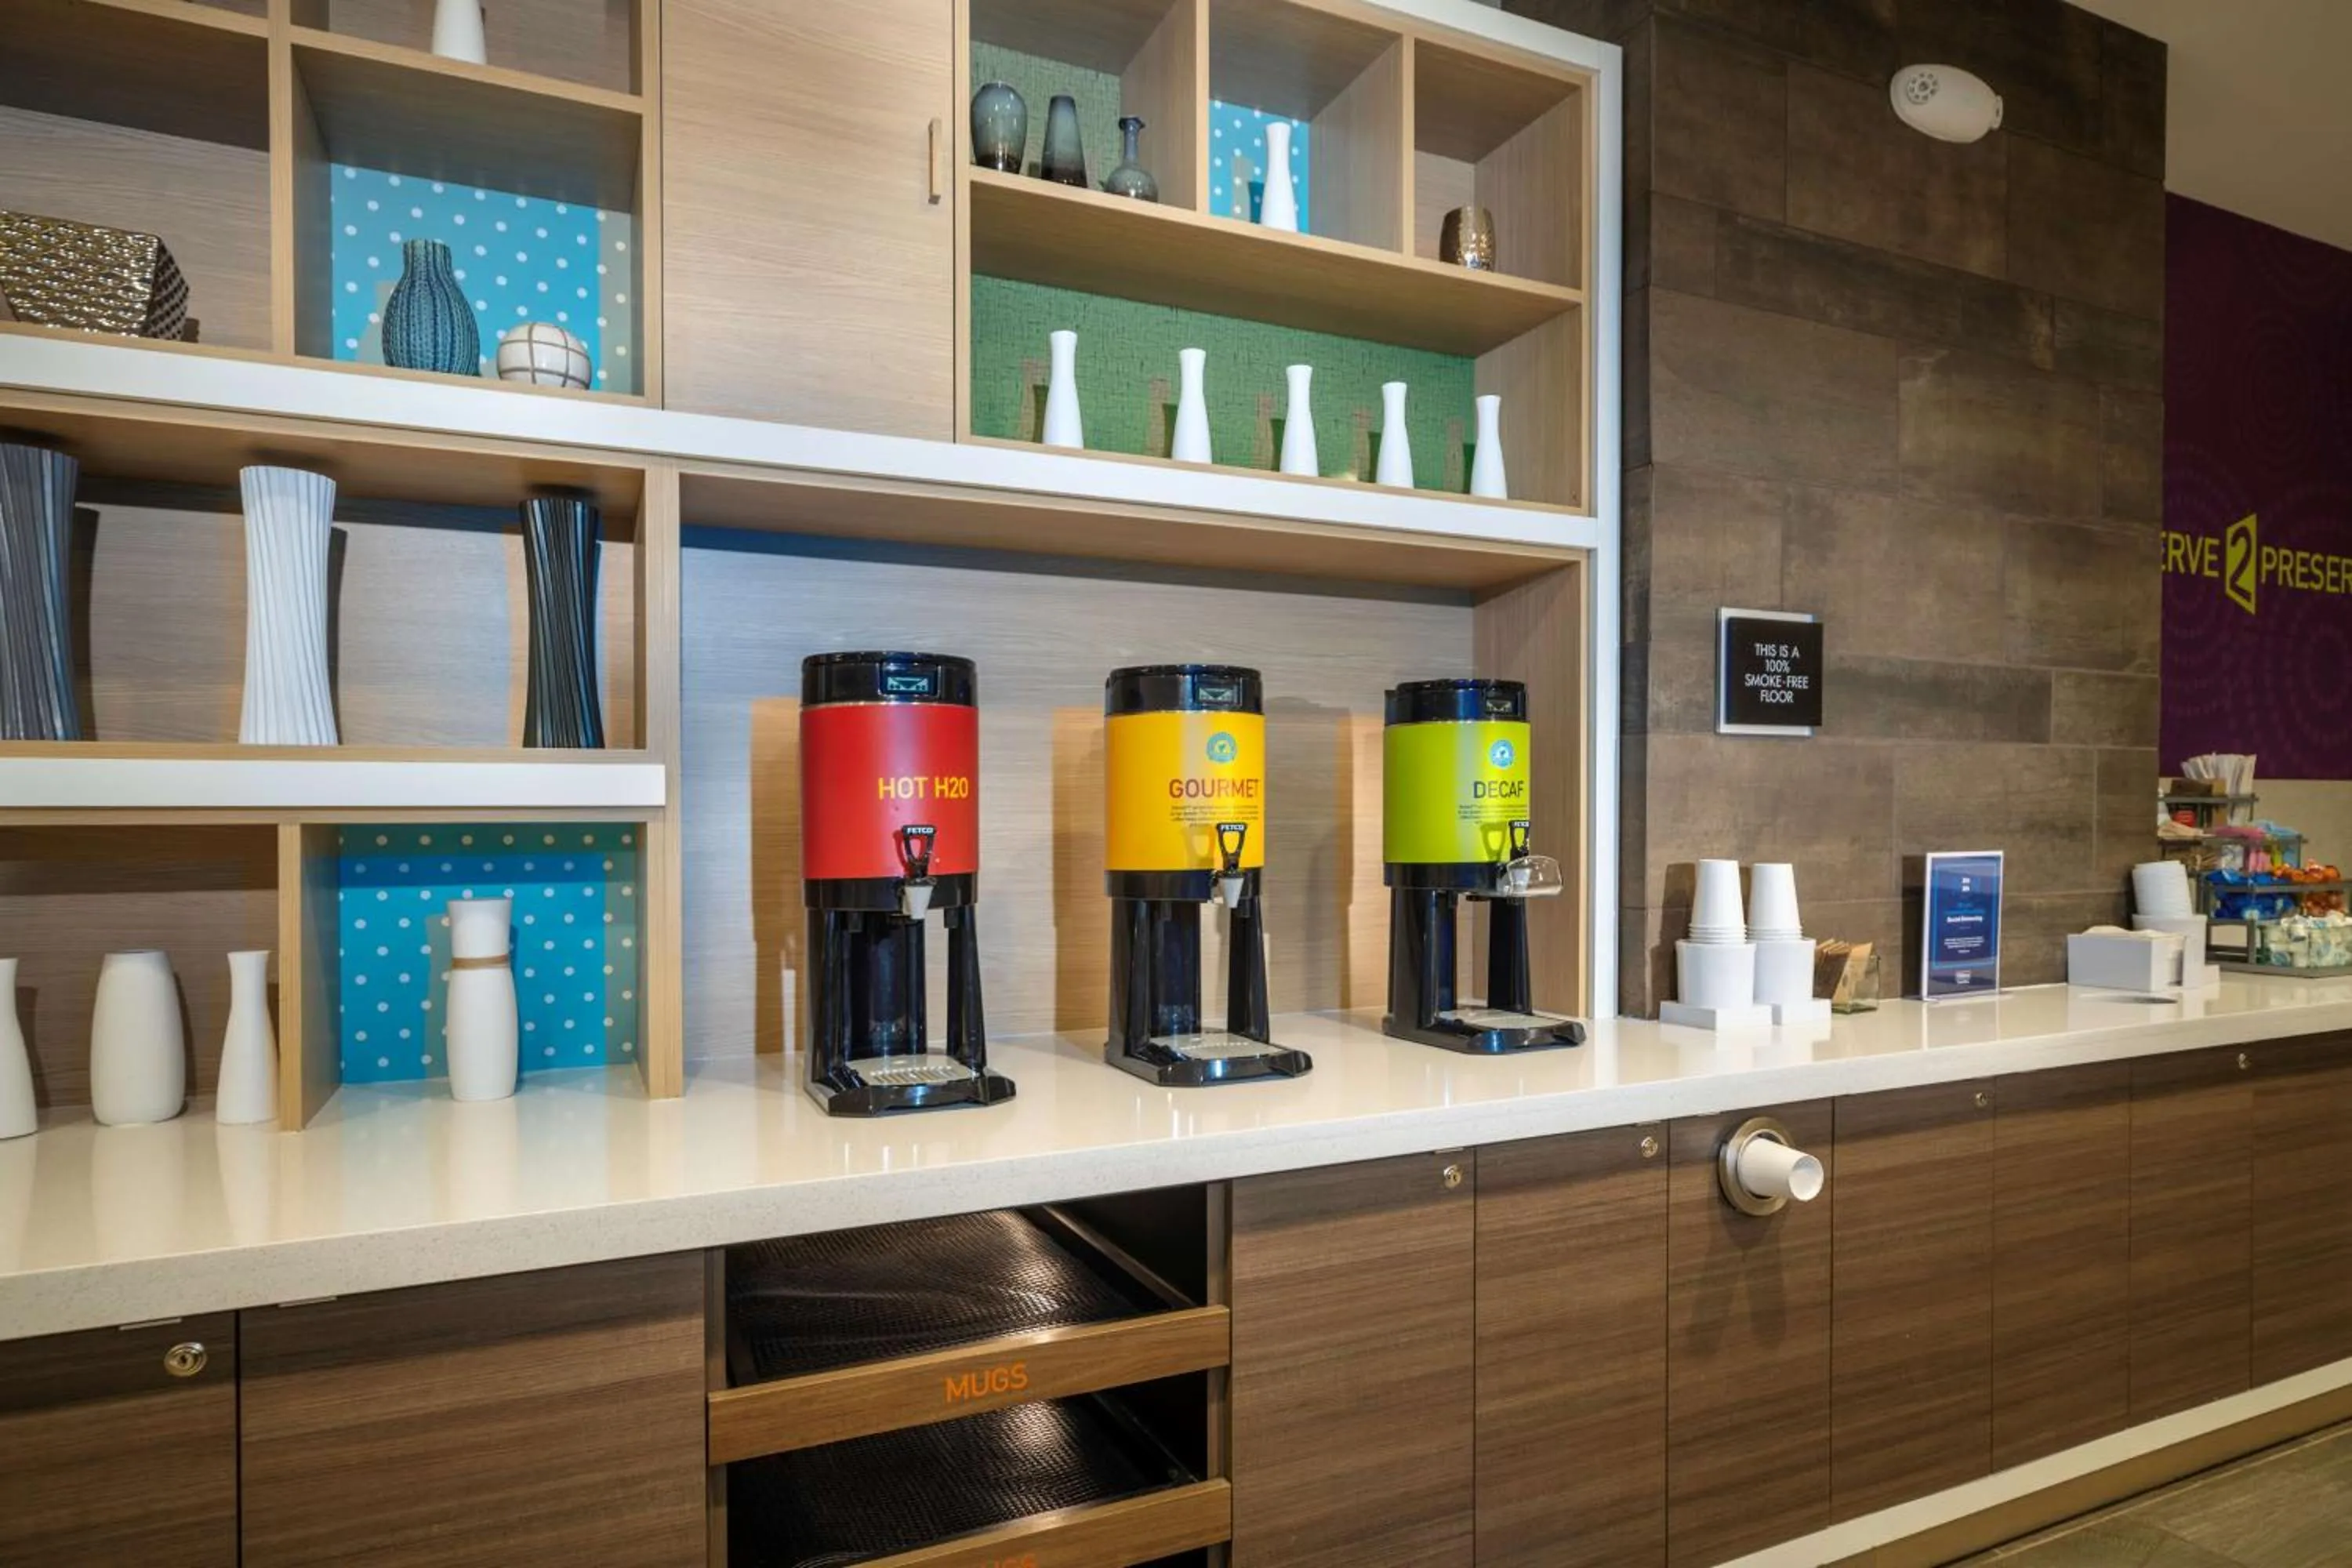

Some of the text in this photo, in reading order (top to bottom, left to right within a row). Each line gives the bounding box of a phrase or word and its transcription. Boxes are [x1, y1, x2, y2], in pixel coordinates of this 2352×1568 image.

[1755, 643, 1799, 658] THIS IS A
[1765, 659, 1791, 673] 100%
[1744, 673, 1809, 689] SMOKE-FREE
[878, 777, 928, 800] HOT
[1169, 779, 1259, 799] GOURMET
[1473, 780, 1524, 799] DECAF
[946, 1363, 1028, 1403] MUGS
